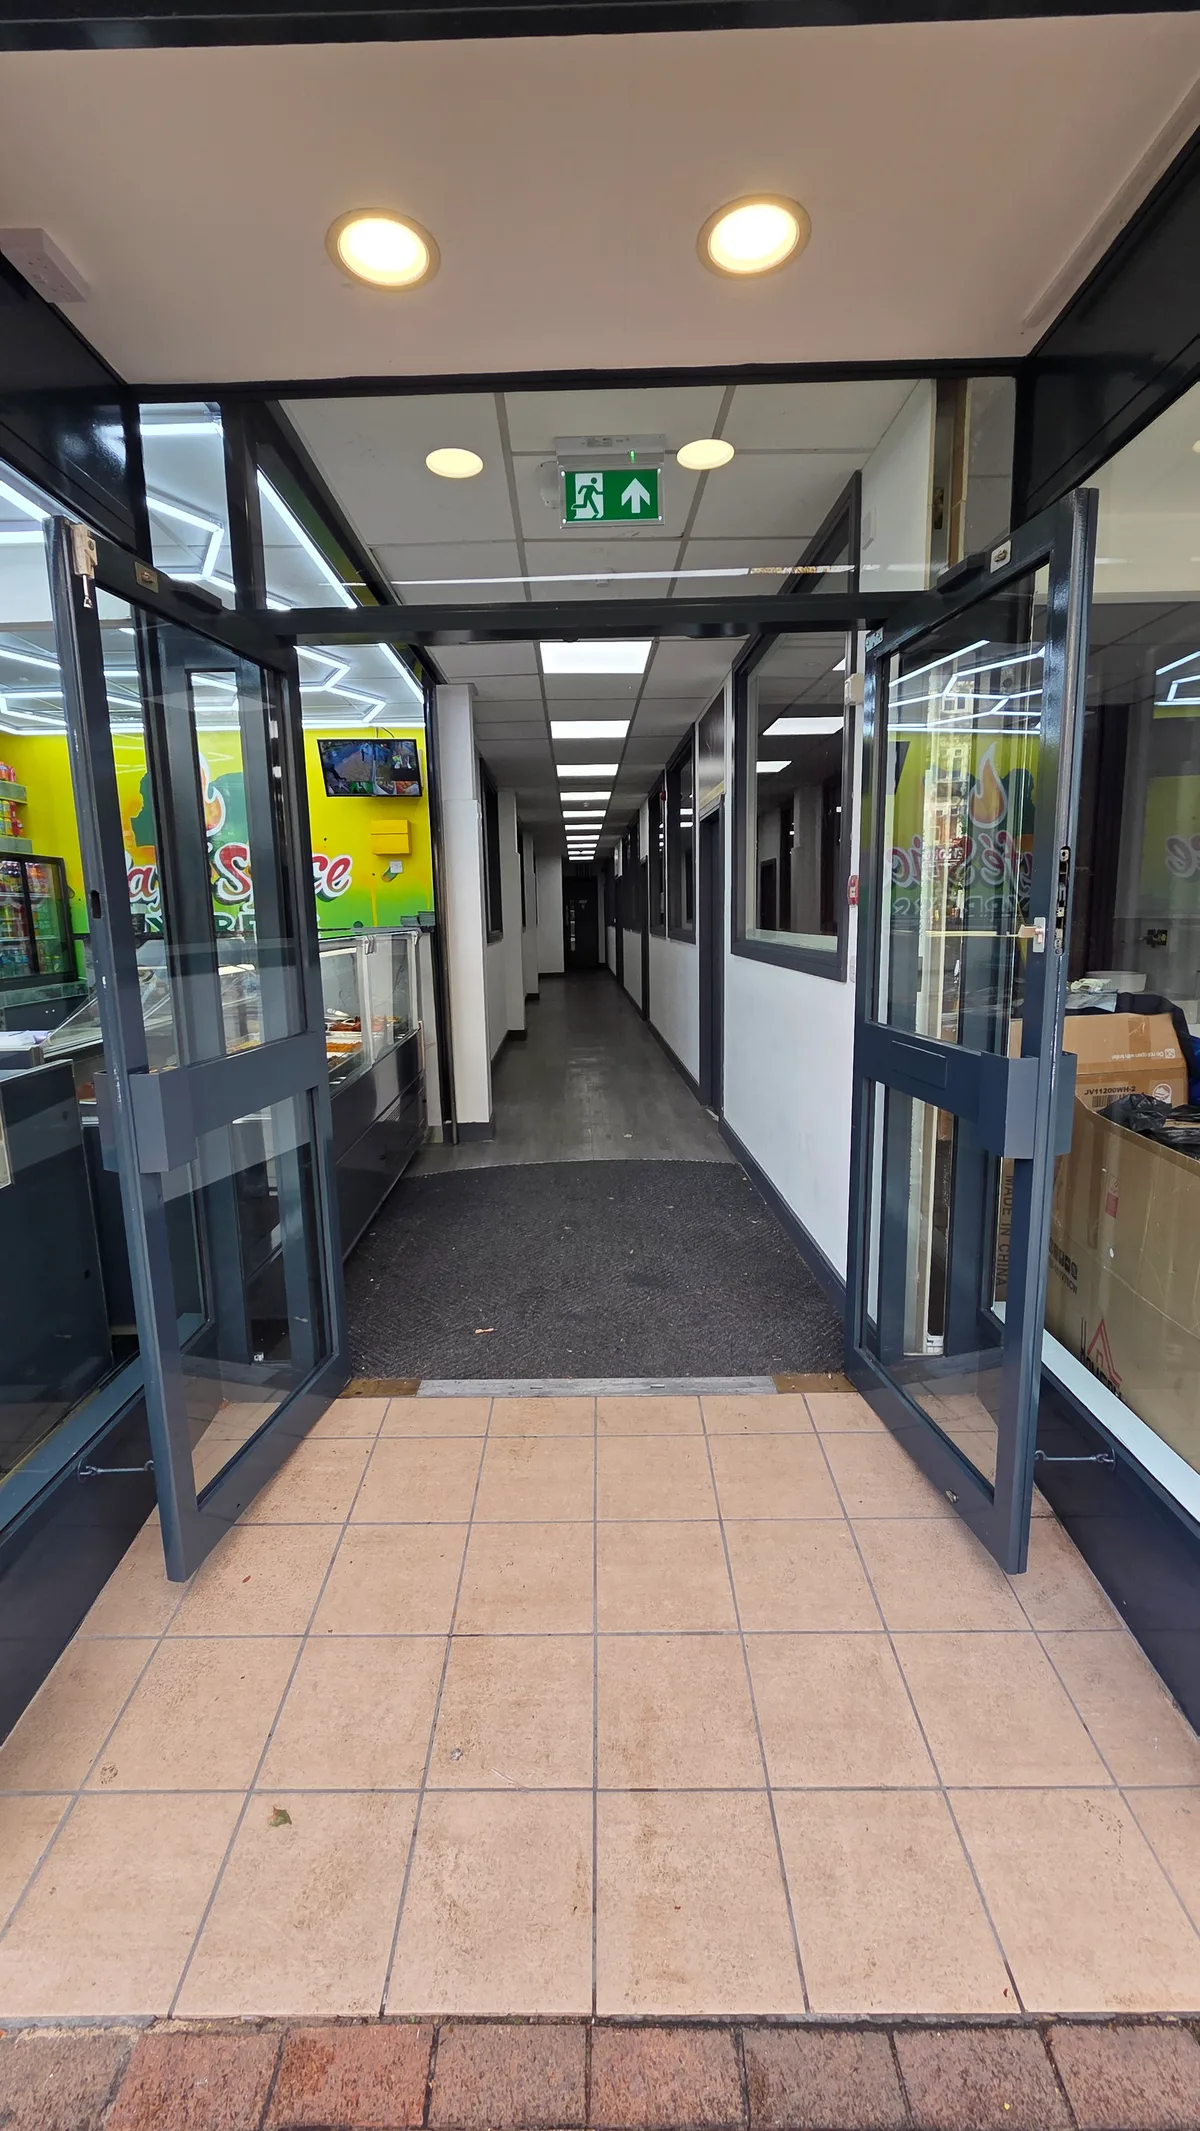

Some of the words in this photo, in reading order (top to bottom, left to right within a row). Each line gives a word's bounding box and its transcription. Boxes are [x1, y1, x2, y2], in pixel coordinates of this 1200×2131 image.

[1002, 1175, 1013, 1216] MADE
[999, 1223, 1011, 1237] IN
[996, 1243, 1010, 1287] CHINA
